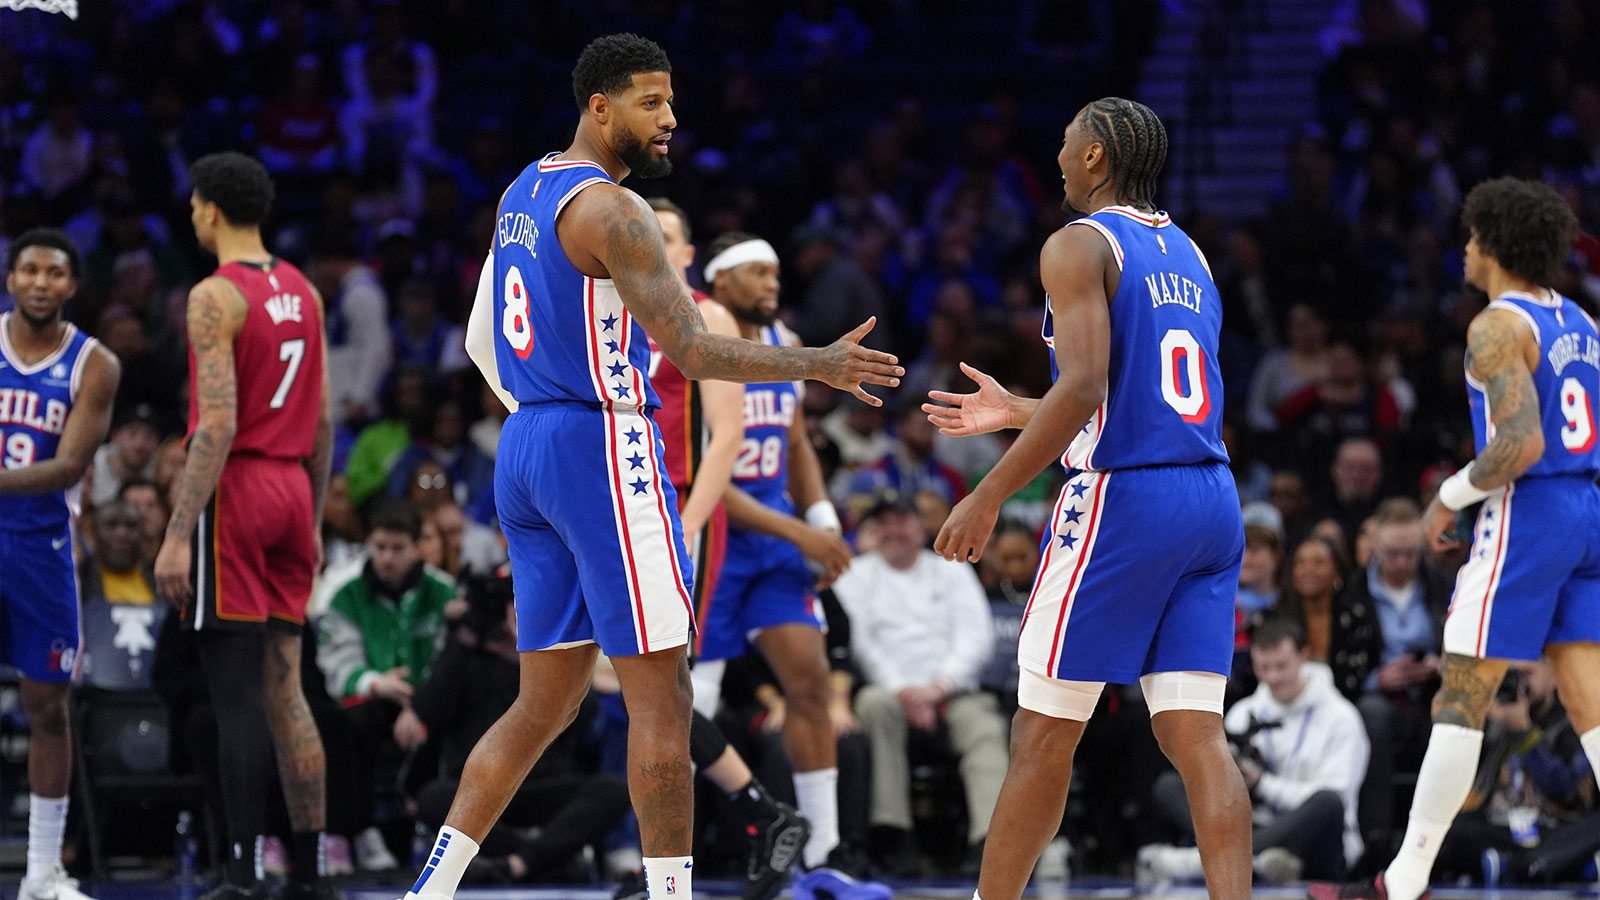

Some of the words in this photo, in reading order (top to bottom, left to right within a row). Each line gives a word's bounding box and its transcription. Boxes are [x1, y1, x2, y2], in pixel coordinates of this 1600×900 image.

[498, 212, 539, 259] GEORGE
[264, 293, 303, 325] WARE
[502, 265, 534, 360] 8
[1145, 272, 1202, 314] MAXEY
[269, 338, 306, 409] 7
[1160, 329, 1211, 424] 0
[1561, 377, 1598, 455] 9
[733, 435, 783, 481] 28
